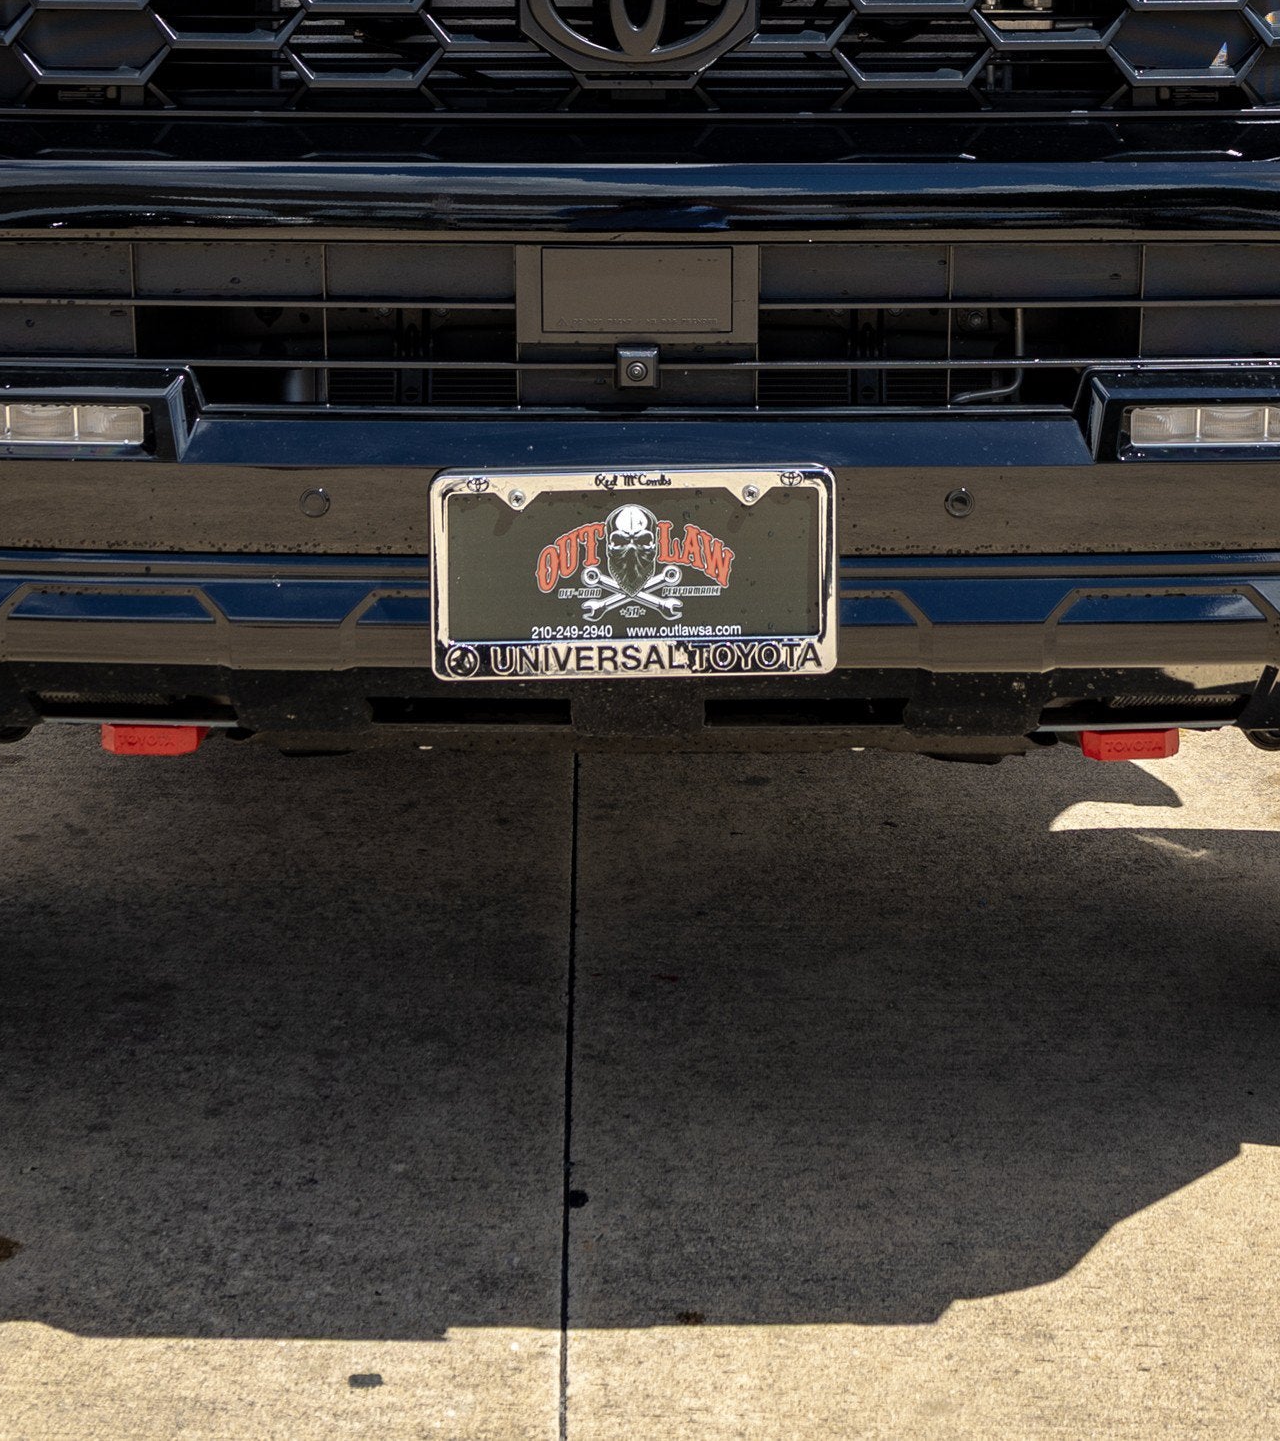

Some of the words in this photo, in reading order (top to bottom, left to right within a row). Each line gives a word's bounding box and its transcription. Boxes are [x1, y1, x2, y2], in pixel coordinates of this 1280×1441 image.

[595, 473, 619, 491] Red
[536, 522, 607, 593] OUT
[656, 520, 736, 588] LAW
[558, 587, 603, 599] OFF-ROAD
[661, 585, 721, 597] PERFORMANCE
[531, 624, 613, 639] 210-249-2940
[626, 623, 742, 638] www.outlawsa.com
[490, 642, 687, 676] UNIVERSAL
[691, 639, 821, 672] TOYOTA
[1105, 740, 1163, 753] TOYOTA
